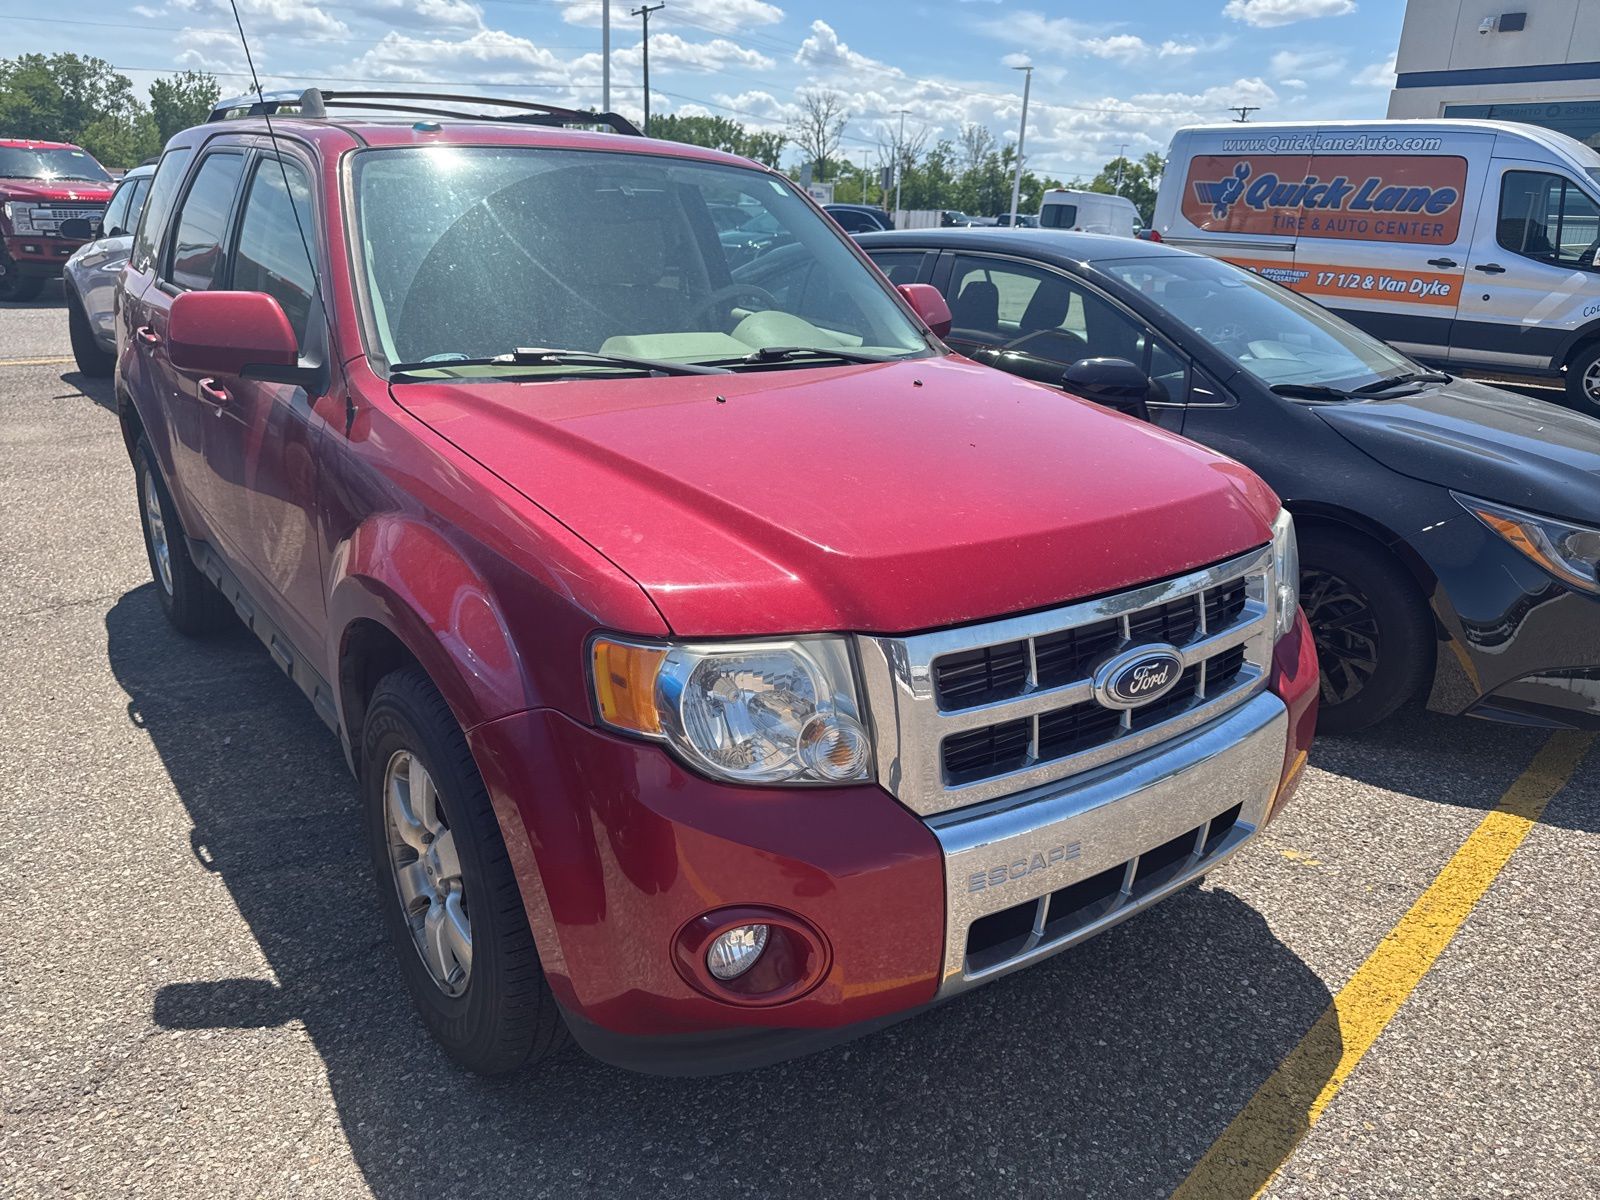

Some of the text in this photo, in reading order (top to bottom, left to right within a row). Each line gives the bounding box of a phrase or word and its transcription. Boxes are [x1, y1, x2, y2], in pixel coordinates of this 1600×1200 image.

[1222, 135, 1442, 153] www.QuickLaneAuto.com
[1245, 172, 1459, 216] Quick Lane
[1272, 215, 1444, 237] TIRE & AUTO CENTER
[1260, 267, 1310, 278] APPOINTMENT
[1316, 272, 1451, 297] 17 1/2 & Van Dyke
[1129, 662, 1169, 694] Ford
[967, 841, 1082, 893] ESCAPE
